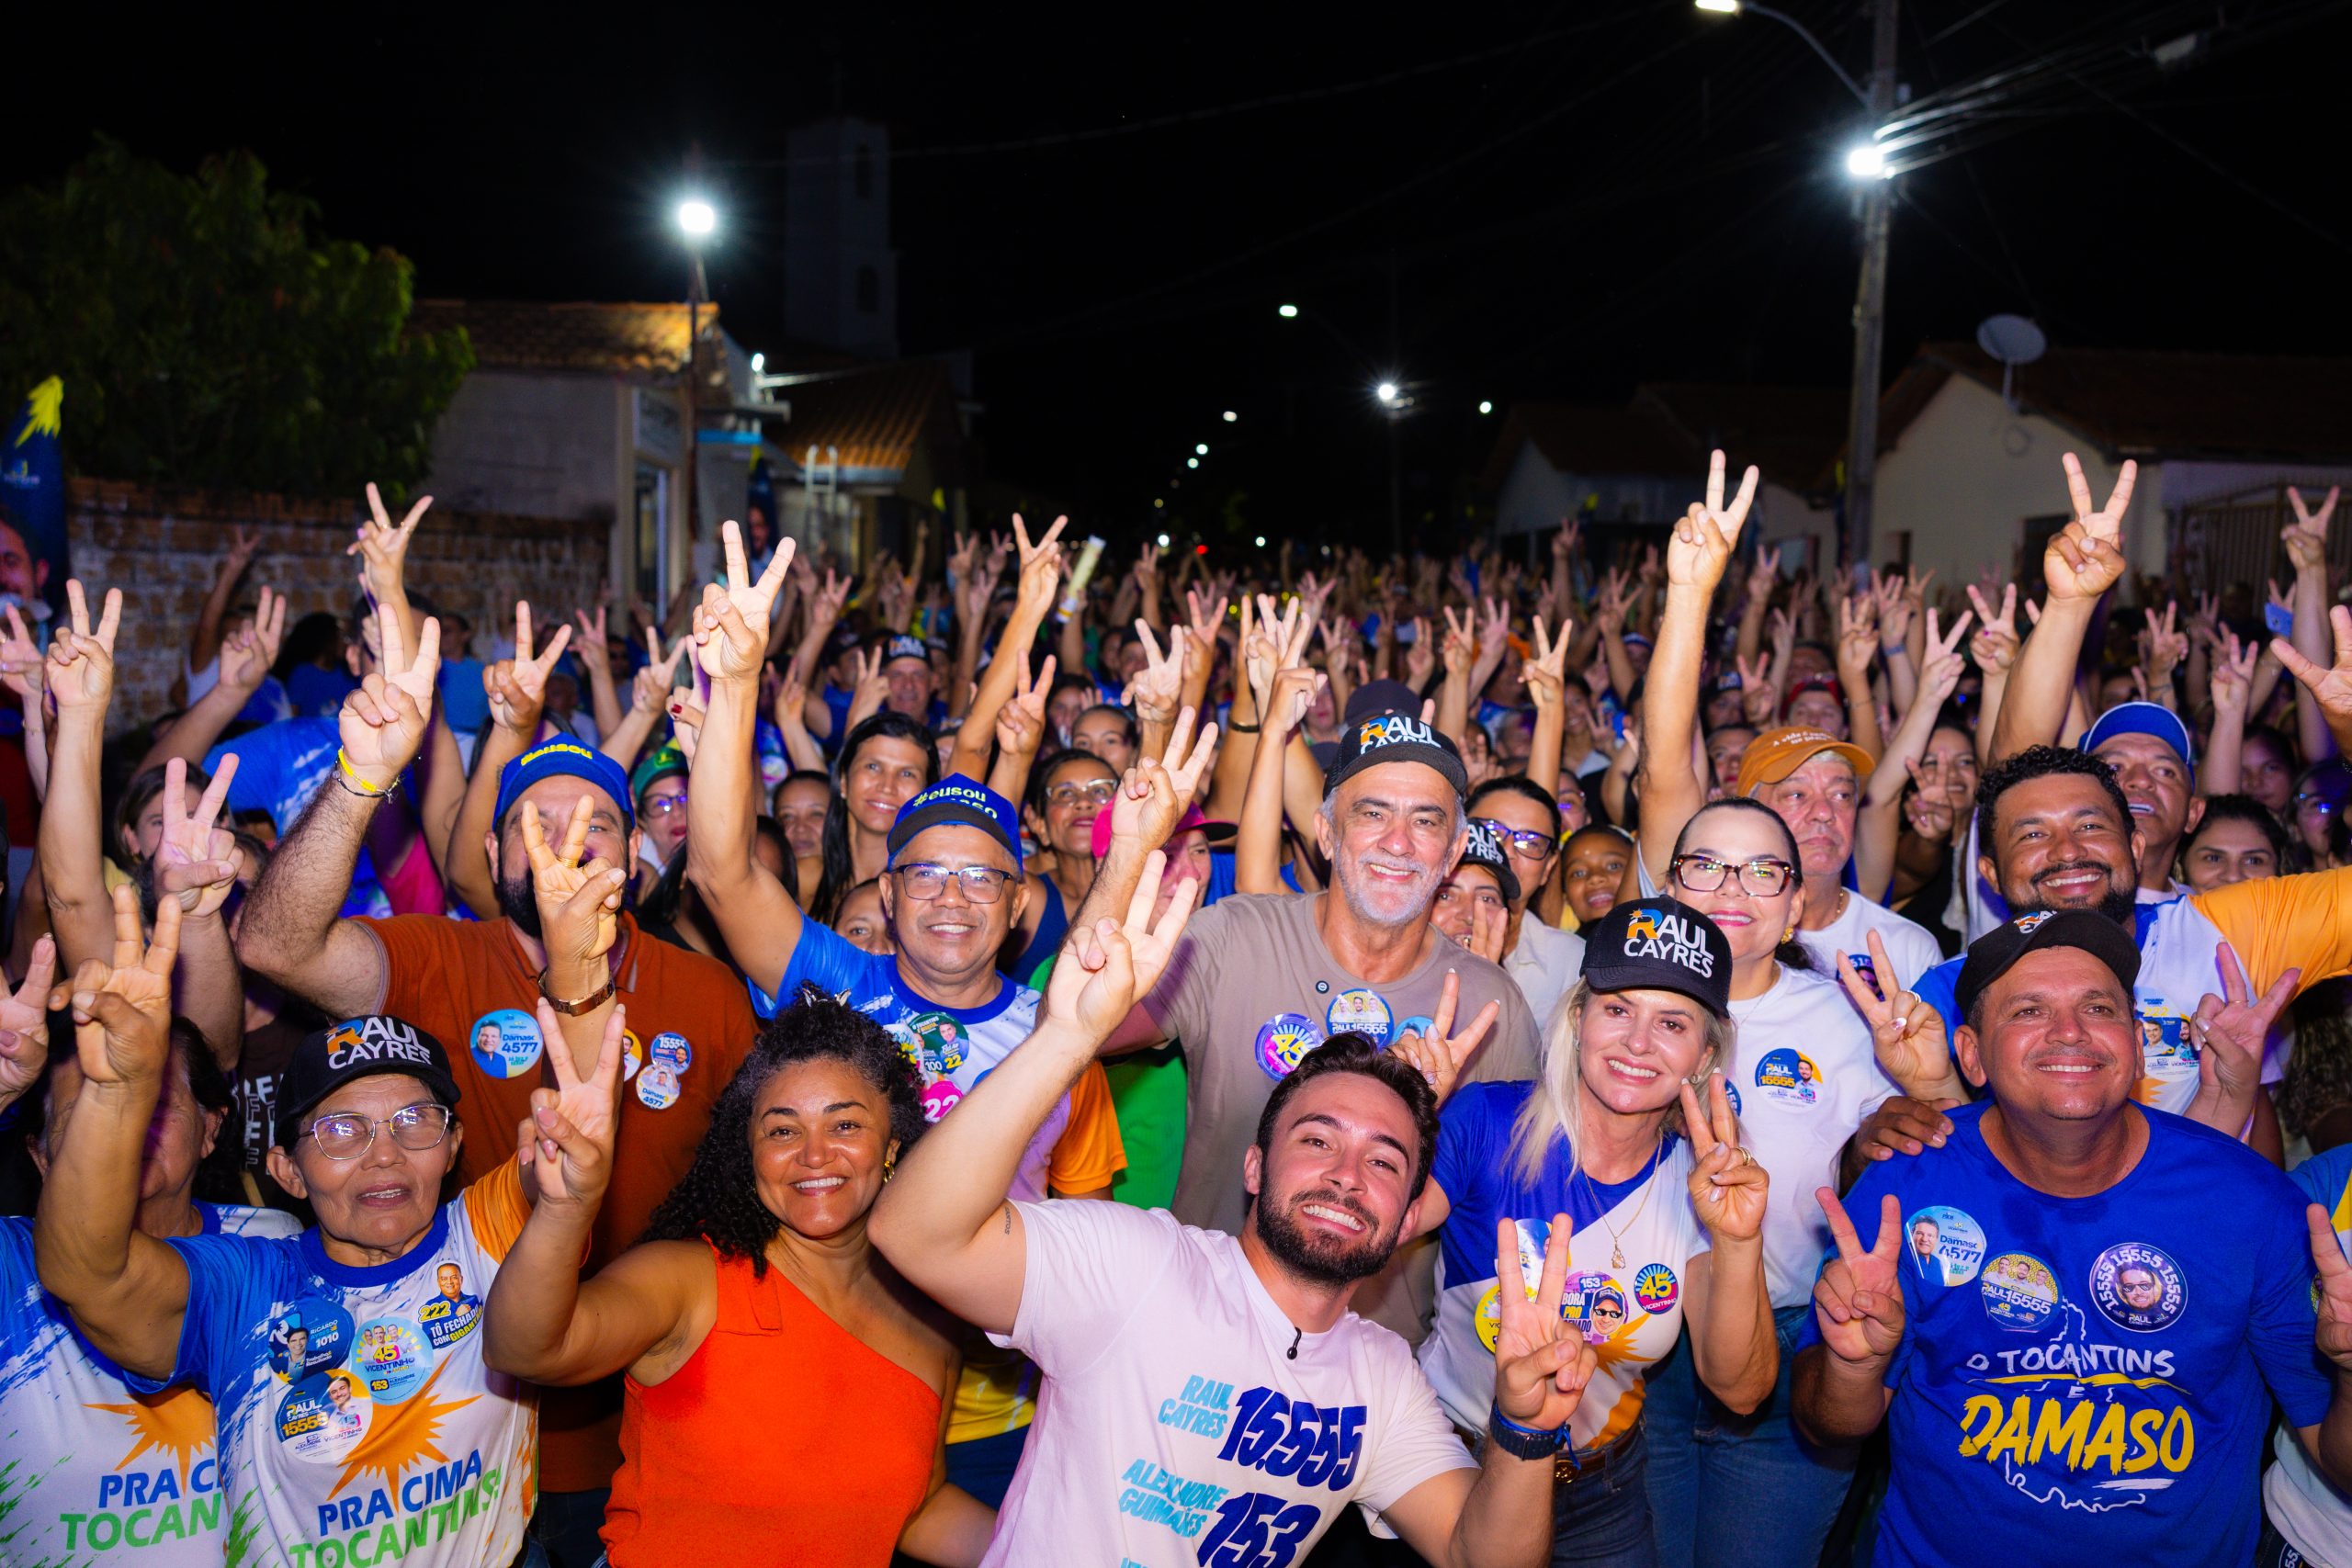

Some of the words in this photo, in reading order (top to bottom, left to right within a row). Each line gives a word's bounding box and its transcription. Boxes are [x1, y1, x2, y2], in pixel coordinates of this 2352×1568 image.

[1360, 716, 1441, 748] RAUL
[912, 786, 986, 807] #eusou
[1467, 824, 1502, 859] AUL
[1626, 908, 1714, 961] RAUL
[1623, 938, 1713, 978] CAYRES
[2143, 1007, 2169, 1018] 222
[324, 1016, 430, 1055] RAUL
[328, 1040, 432, 1070] CAYRES
[501, 1042, 538, 1054] 4577
[944, 1054, 964, 1069] 22
[1766, 1064, 1793, 1076] RAUL
[1761, 1075, 1797, 1088] 15555
[643, 1096, 663, 1107] 4577
[1938, 1245, 1982, 1263] 4577
[2109, 1248, 2164, 1269] 15555
[1579, 1277, 1600, 1289] 153
[1639, 1272, 1672, 1300] 45
[1562, 1292, 1586, 1306] BORA
[1981, 1281, 2008, 1299] RAUL
[2005, 1290, 2052, 1314] 15555
[420, 1301, 451, 1323] 222
[1563, 1305, 1582, 1319] PRO
[2128, 1314, 2153, 1324] RAUL
[310, 1319, 338, 1335] RICARDO
[430, 1322, 443, 1338] TÔ
[315, 1332, 340, 1348] 1010
[433, 1336, 451, 1347] COM
[373, 1344, 398, 1362] 45
[1967, 1353, 1989, 1371] O
[1997, 1343, 2176, 1378] TOCANTINS
[364, 1357, 415, 1372] VICENTINHO
[371, 1380, 389, 1391] 153
[1180, 1375, 1234, 1411] RAUL
[286, 1399, 322, 1418] RAUL
[1157, 1398, 1228, 1439] CAYRES
[282, 1411, 329, 1437] 15555
[1959, 1393, 2195, 1476] DAMASO
[1217, 1386, 1368, 1492] 15.555
[98, 1469, 180, 1508] PRA
[318, 1488, 394, 1537] PRA
[401, 1449, 482, 1512] CIMA
[60, 1492, 222, 1551] TOCAN
[1197, 1492, 1321, 1568] 153
